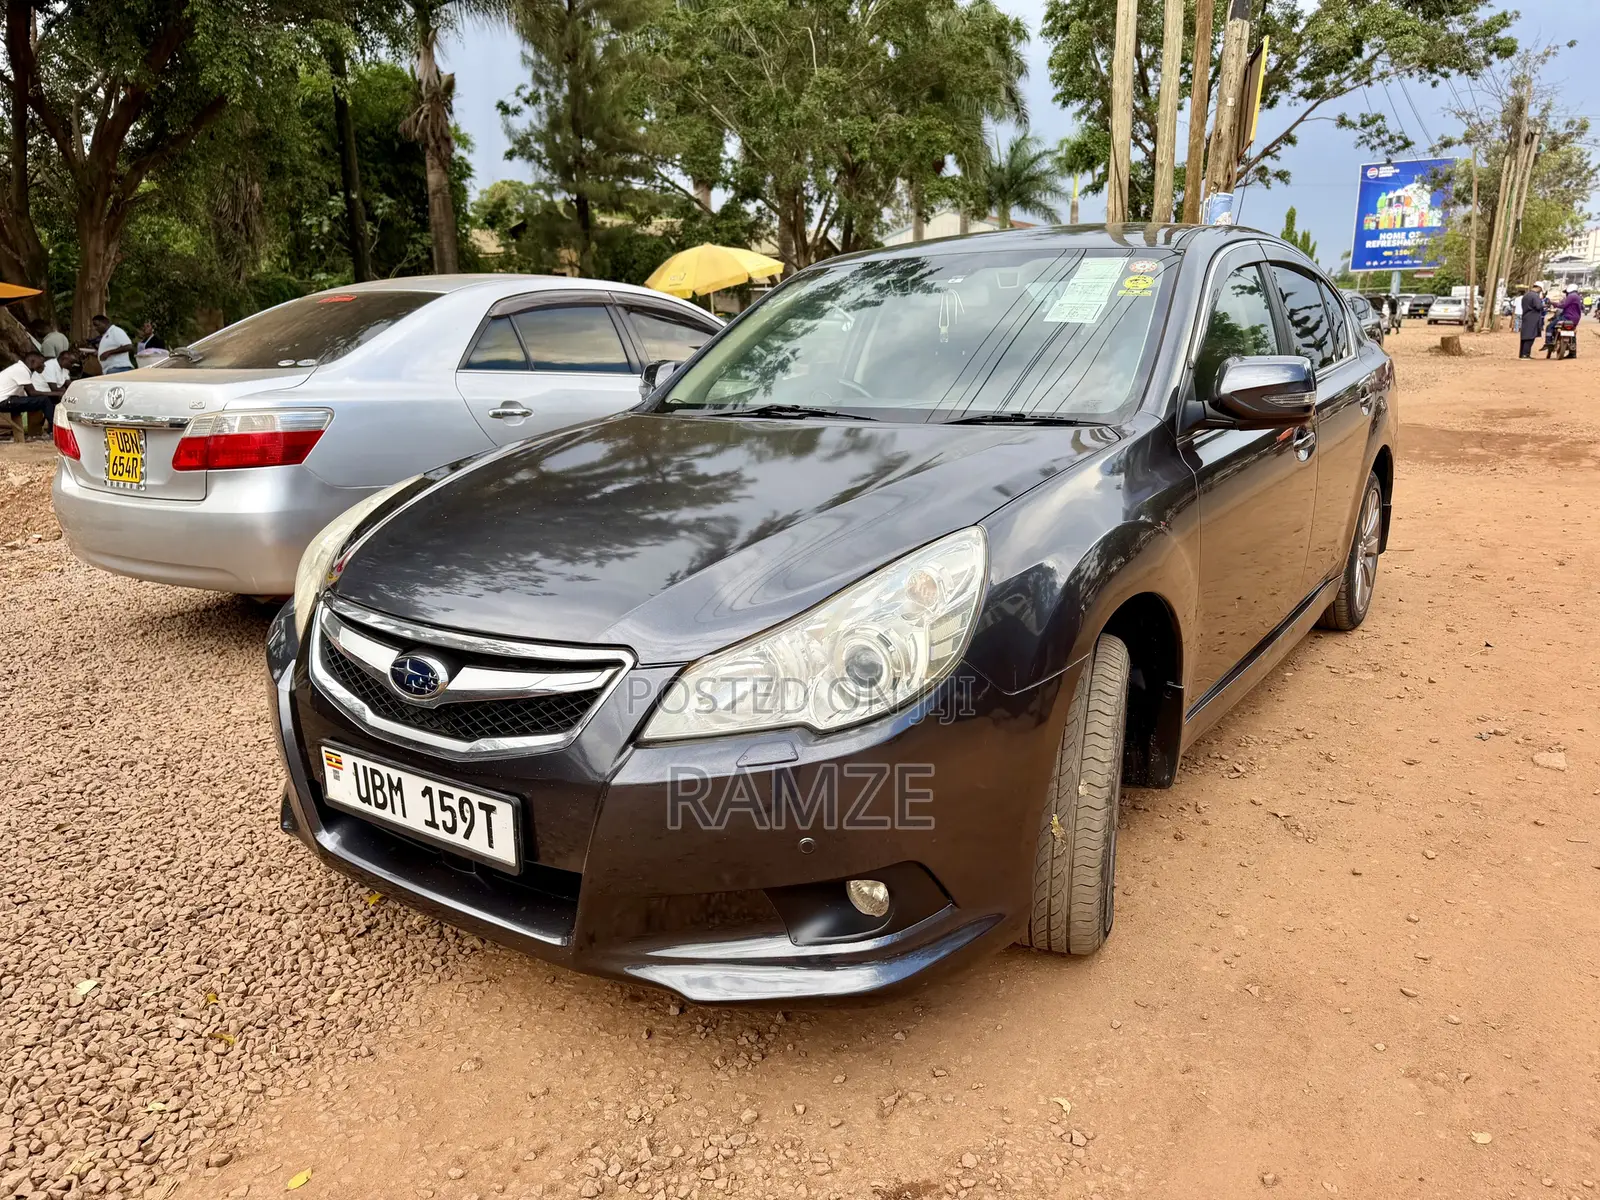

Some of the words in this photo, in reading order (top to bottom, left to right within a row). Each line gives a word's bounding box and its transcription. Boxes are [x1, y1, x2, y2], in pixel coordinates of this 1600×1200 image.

[115, 431, 140, 454] UBN
[112, 455, 138, 479] 654R
[353, 761, 407, 818] UBM
[421, 785, 497, 849] 159T
